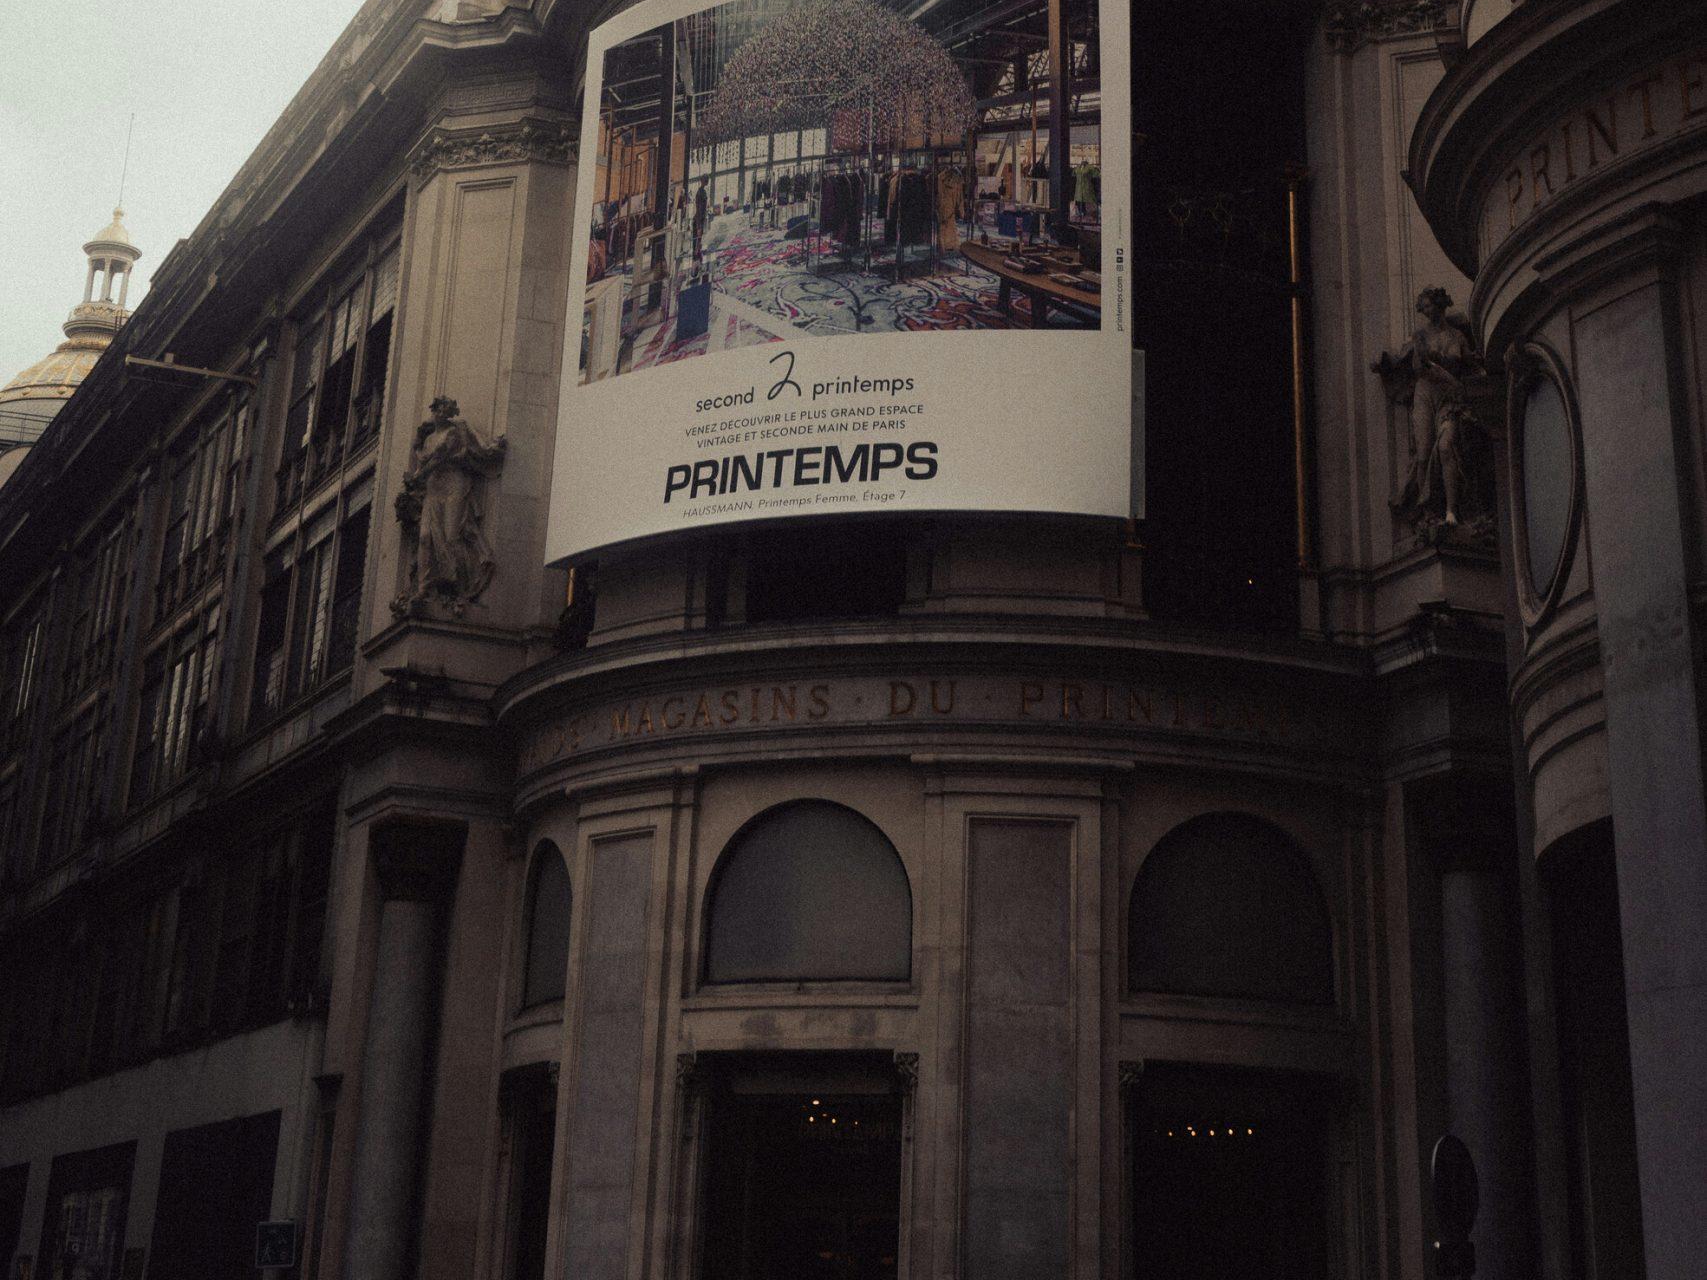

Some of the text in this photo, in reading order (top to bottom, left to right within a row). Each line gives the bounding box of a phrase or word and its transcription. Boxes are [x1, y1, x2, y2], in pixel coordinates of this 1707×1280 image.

[1116, 276, 1124, 332] printemps.com
[695, 351, 915, 412] second 2 printemps
[685, 423, 717, 438] VENEZ
[784, 411, 797, 422] LE
[800, 408, 827, 421] PLUS
[831, 405, 876, 418] GRAND
[879, 403, 924, 416] ESPACE
[697, 419, 906, 449] VINTAGE ET SECONDE MAIN DE PARIS
[663, 441, 938, 504] PRINTEMPS
[862, 490, 895, 504] Étage
[898, 490, 906, 501] 7
[609, 683, 830, 741] MAGASINS
[888, 680, 957, 716] DU
